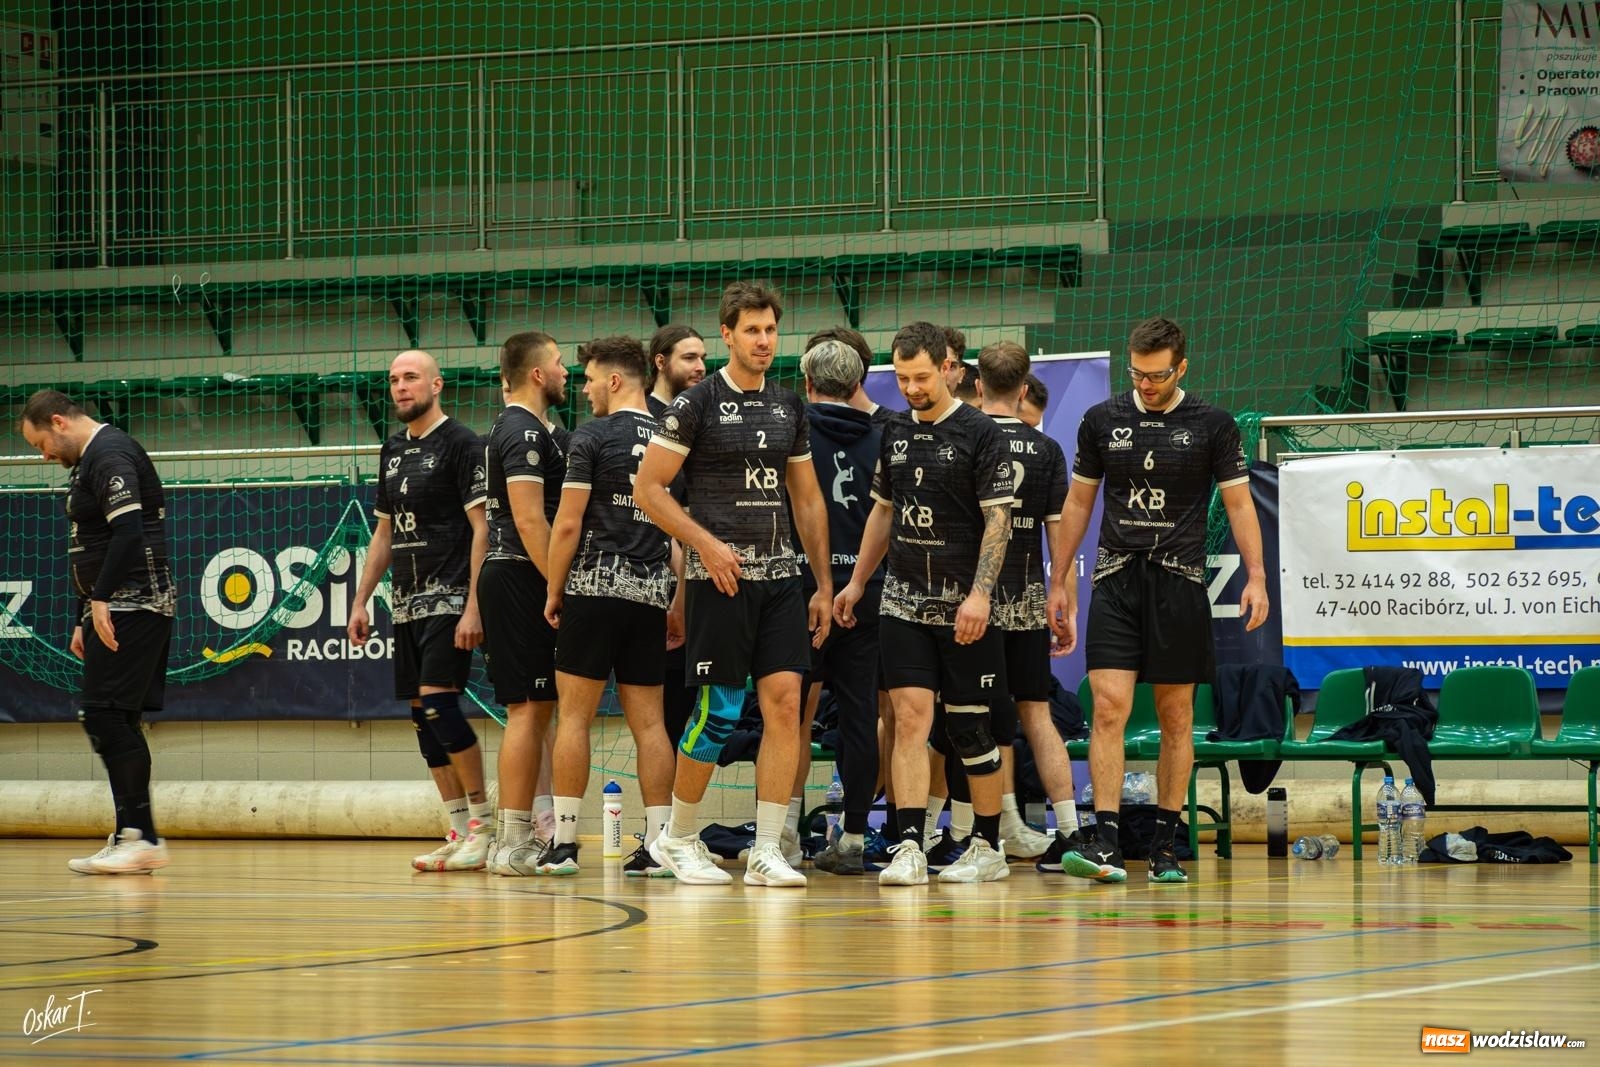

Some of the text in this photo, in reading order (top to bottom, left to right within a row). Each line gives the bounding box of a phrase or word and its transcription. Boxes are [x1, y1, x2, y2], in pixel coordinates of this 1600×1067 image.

[1534, 2, 1600, 39] MI
[1546, 52, 1598, 62] poszukuje
[719, 414, 743, 422] radlin
[756, 430, 768, 449] 2
[1026, 441, 1038, 455] K.
[1108, 439, 1133, 449] radlin
[1143, 450, 1155, 471] 6
[399, 476, 409, 495] 4
[745, 467, 779, 490] KB
[914, 466, 924, 487] 9
[992, 480, 1013, 488] POLSK
[1127, 488, 1166, 510] KB
[901, 504, 934, 528] KB
[1012, 516, 1035, 529] KLUB
[1302, 570, 1587, 589] tel. 32 414 92 88, 502 632 695,
[1316, 601, 1381, 617] 47-400
[1387, 598, 1470, 617] Racibórz,
[1475, 597, 1497, 615] ul.
[1503, 597, 1516, 615] J.
[1522, 601, 1556, 614] von
